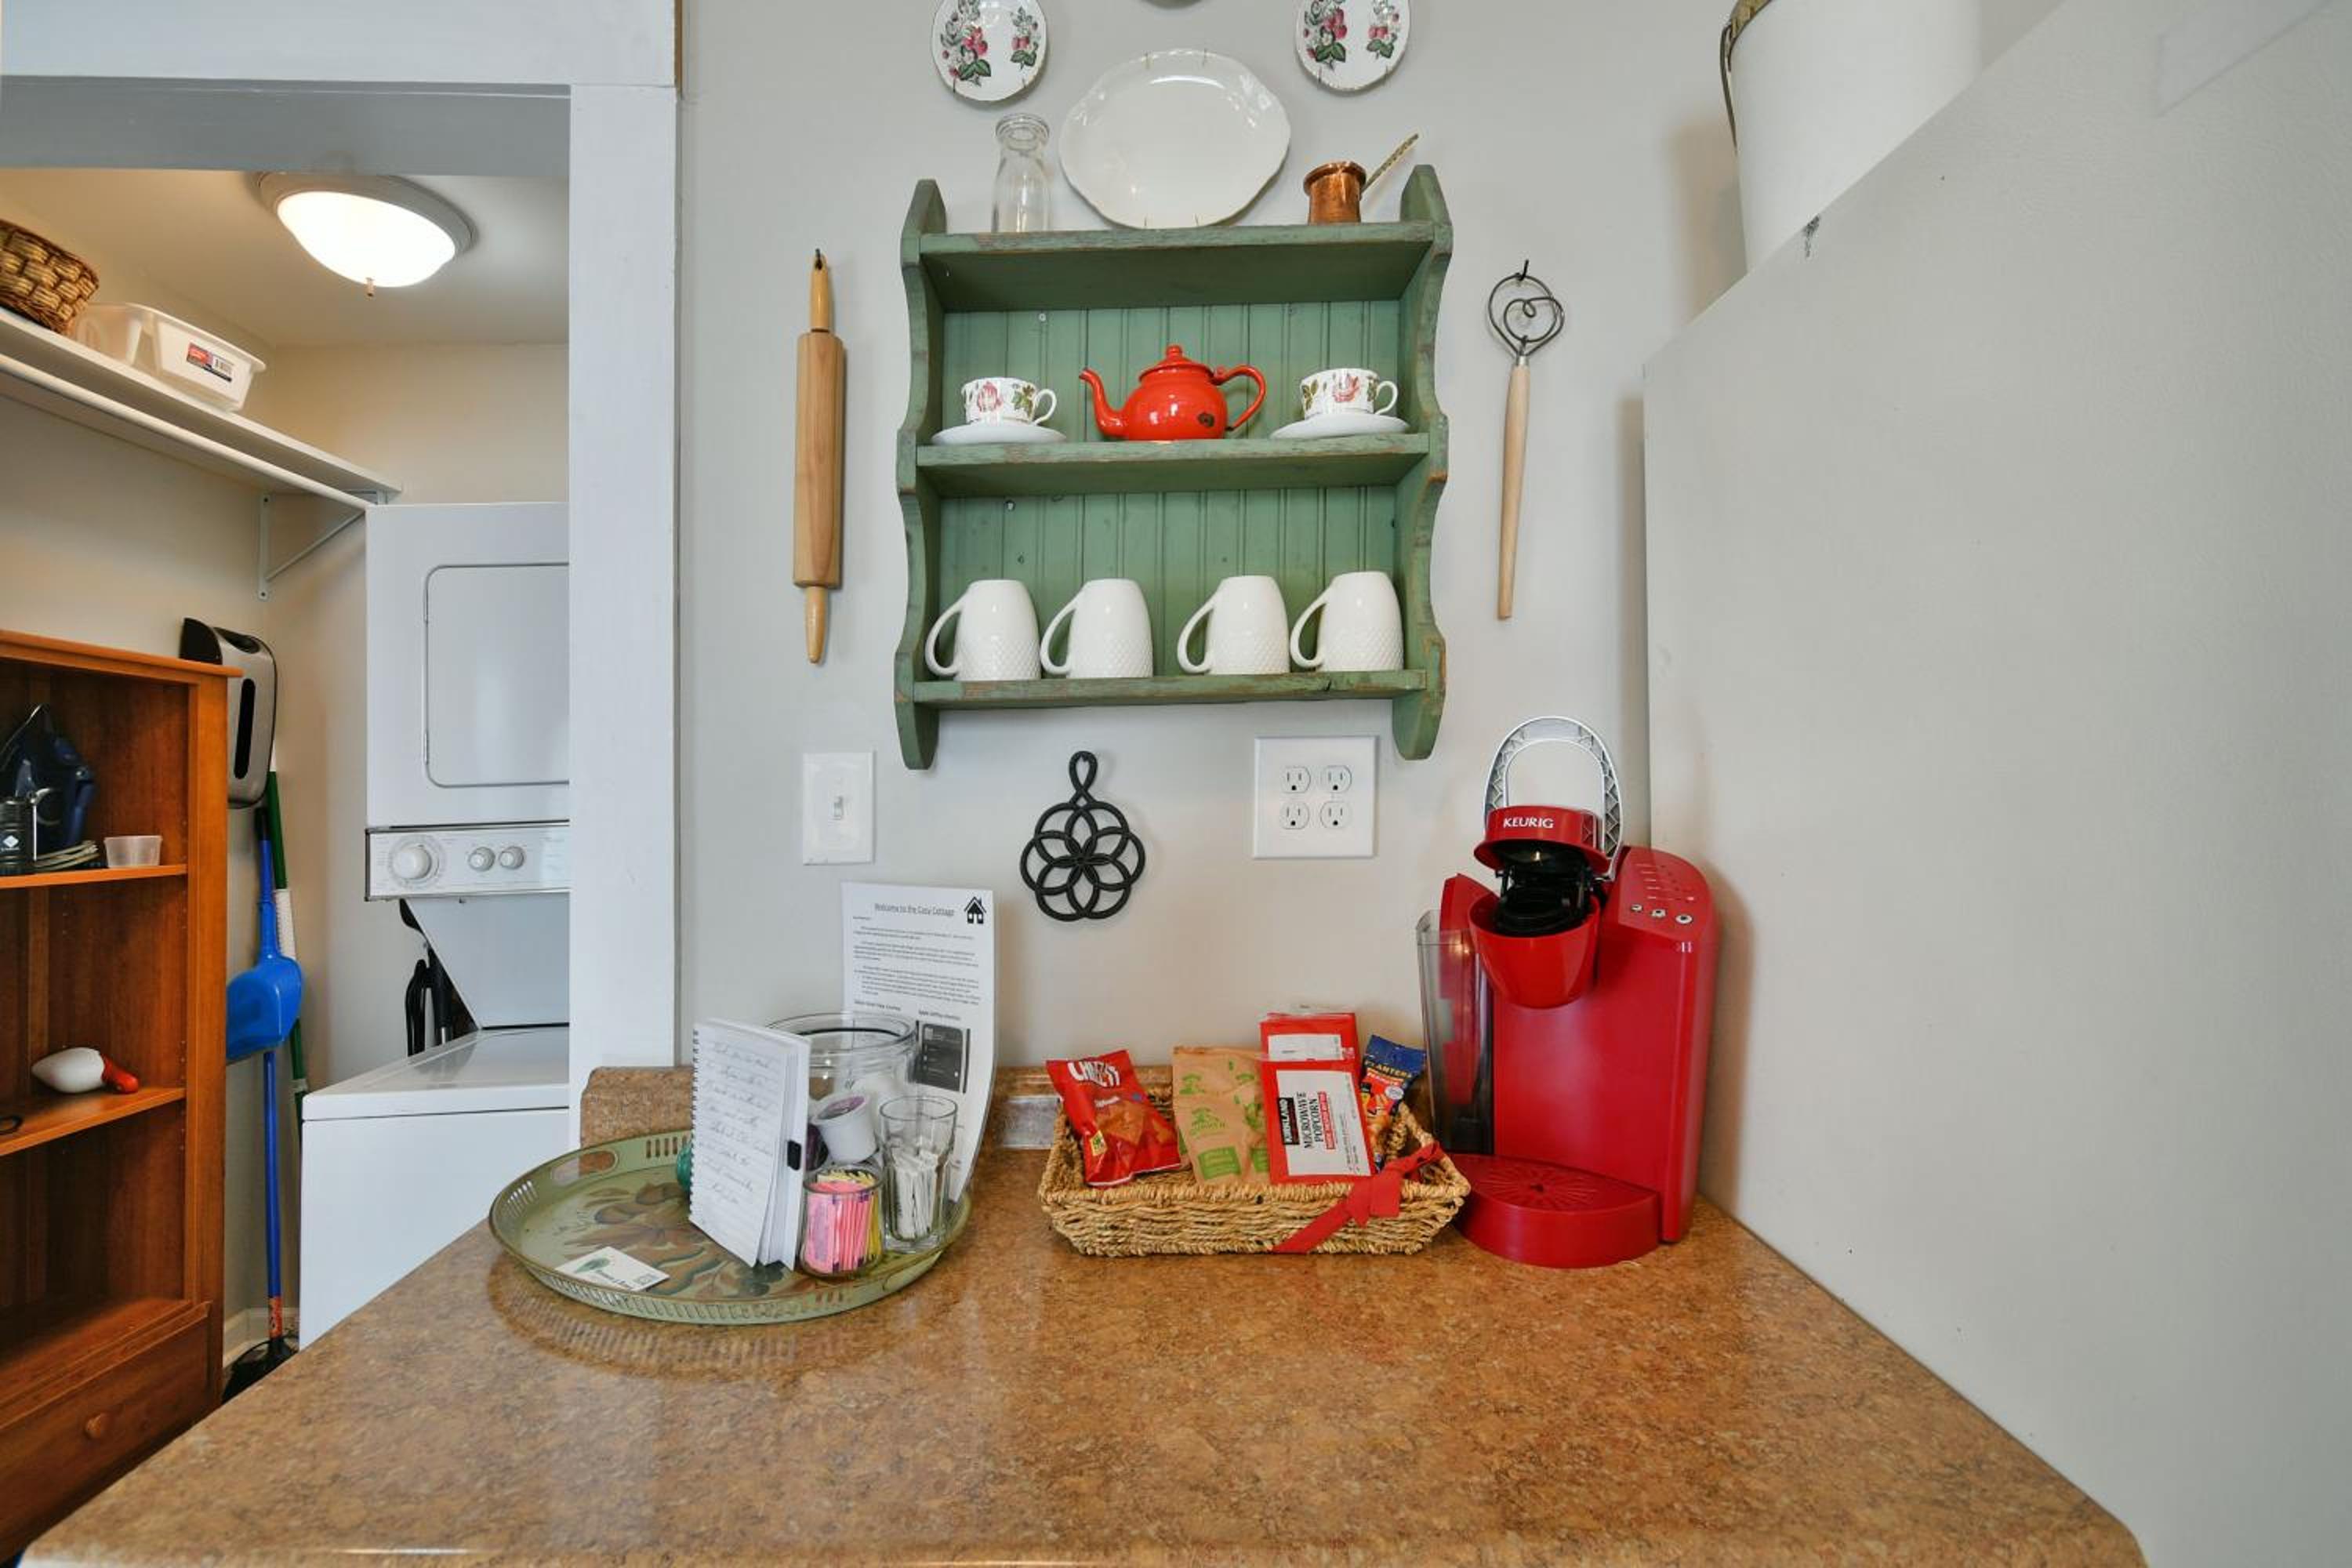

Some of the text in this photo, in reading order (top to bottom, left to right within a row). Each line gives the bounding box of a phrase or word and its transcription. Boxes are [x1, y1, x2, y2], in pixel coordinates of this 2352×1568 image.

[1503, 816, 1554, 829] KEURIG
[1296, 1091, 1313, 1149] MICROWAVE
[1308, 1098, 1323, 1142] POPCORN
